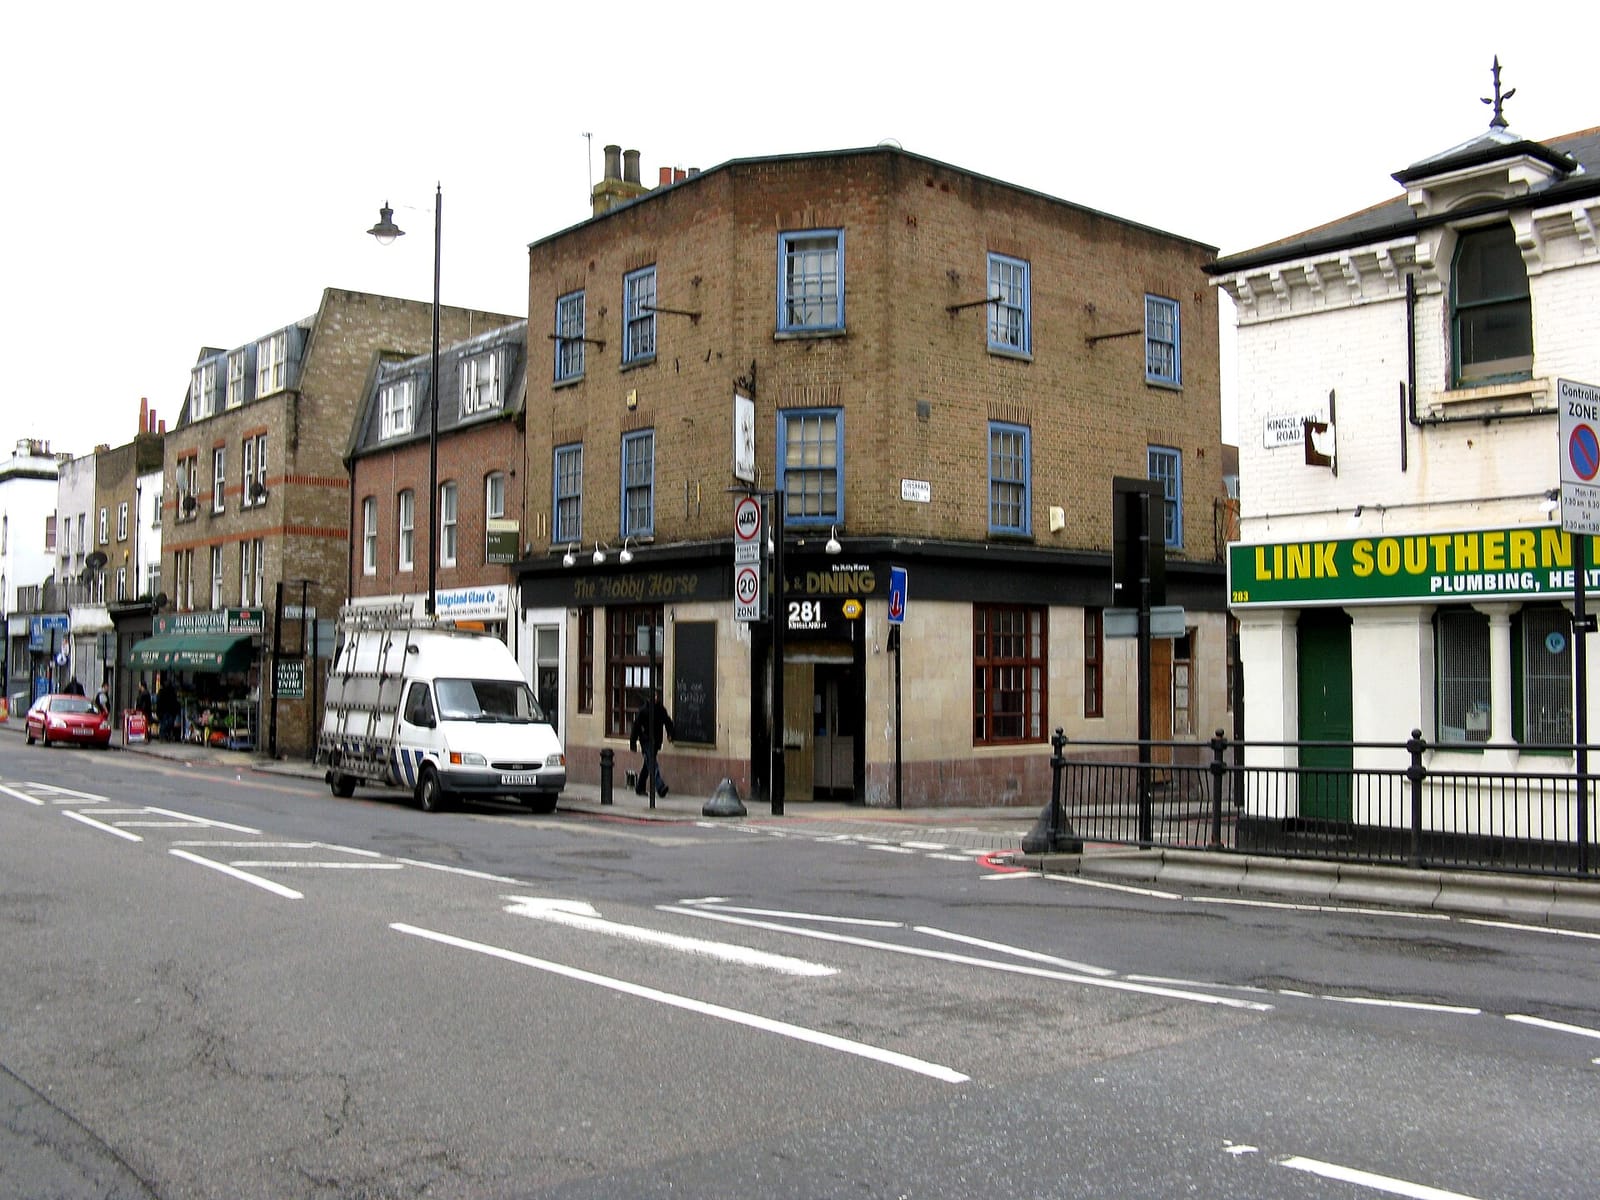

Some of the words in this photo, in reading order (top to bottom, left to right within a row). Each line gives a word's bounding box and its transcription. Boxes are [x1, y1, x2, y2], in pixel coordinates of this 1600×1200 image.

[1562, 384, 1600, 402] Controlle
[1568, 402, 1598, 421] ZONE
[1267, 415, 1318, 431] KINGSLAND
[1277, 430, 1300, 442] ROAD
[903, 489, 920, 500] ROAD
[1581, 511, 1591, 521] Sat
[1255, 542, 1339, 581] LINK
[1352, 528, 1572, 577] SOUTHERN
[575, 579, 595, 600] The
[600, 575, 645, 601] Hobby
[648, 573, 698, 597] Horse
[740, 578, 756, 594] 20
[806, 571, 876, 594] DINING
[1430, 573, 1541, 593] PLUMBING,
[437, 592, 467, 607] Kingsland
[468, 590, 485, 604] Glass
[487, 589, 496, 603] Co
[737, 607, 757, 618] ZONE
[788, 600, 821, 622] 281
[788, 620, 820, 630] KINGSLAND
[278, 680, 300, 689] ENTRE
